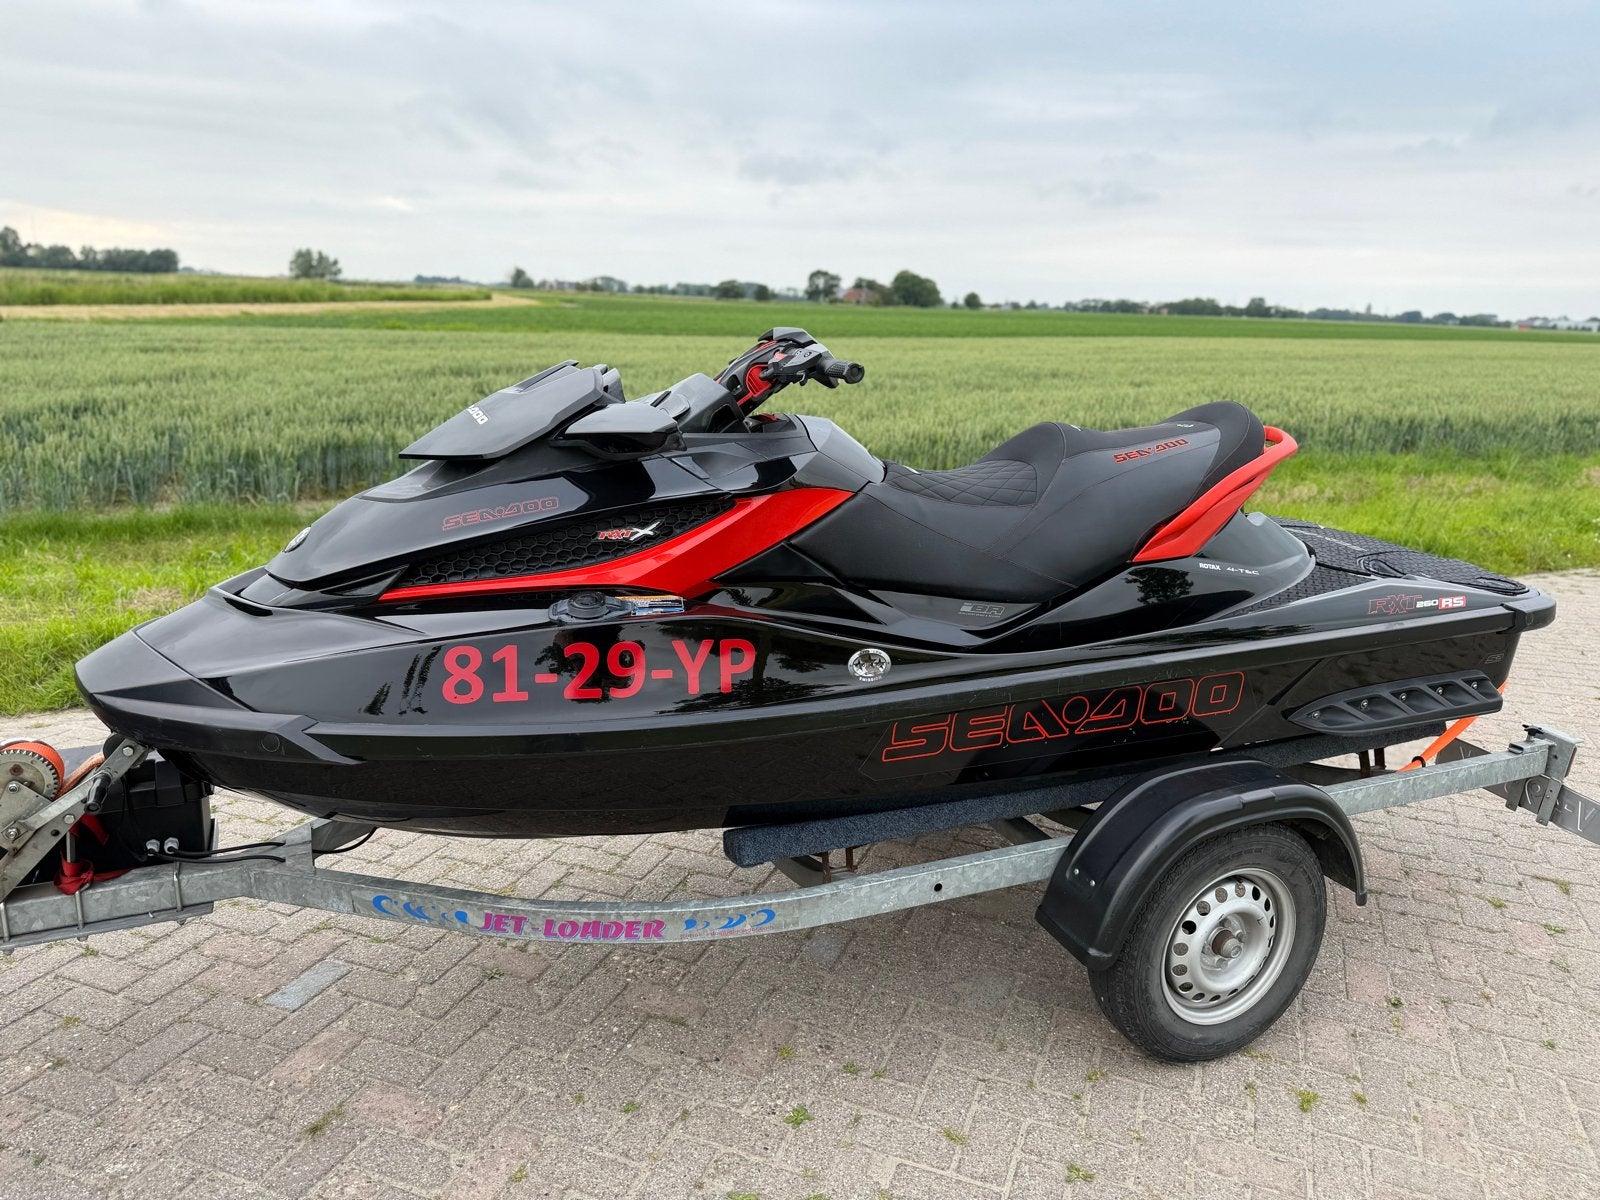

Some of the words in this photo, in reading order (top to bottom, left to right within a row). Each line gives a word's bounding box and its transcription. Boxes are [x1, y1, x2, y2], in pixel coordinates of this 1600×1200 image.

[1199, 562, 1221, 571] ROTAX
[1416, 599, 1439, 609] 260
[1439, 596, 1467, 610] RS
[442, 638, 756, 705] 81-29-YP
